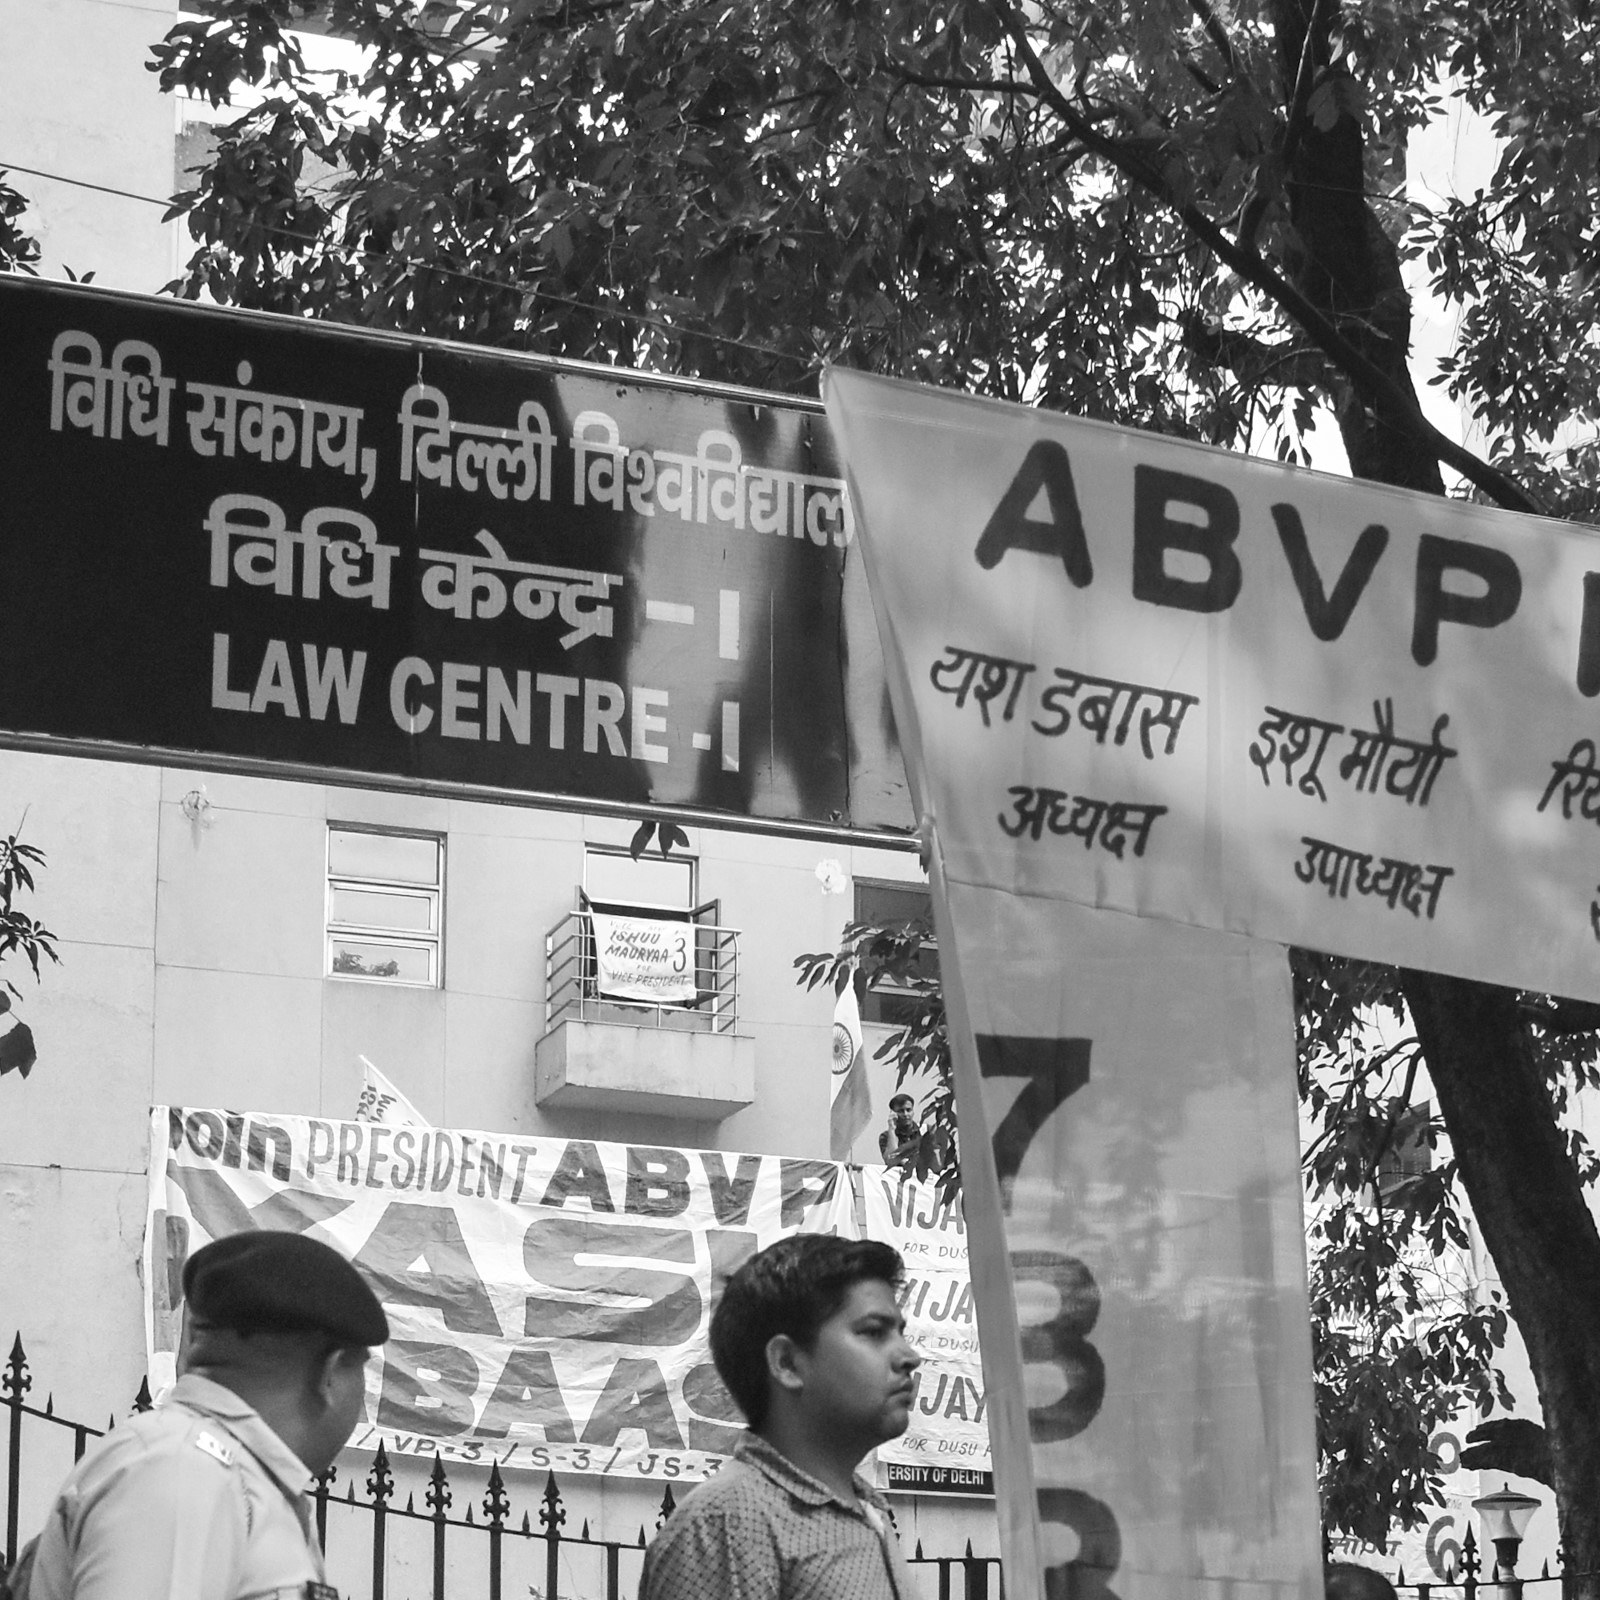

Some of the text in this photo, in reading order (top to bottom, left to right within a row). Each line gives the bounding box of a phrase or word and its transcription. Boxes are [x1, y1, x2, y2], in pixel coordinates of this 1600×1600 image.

[48, 329, 854, 547] विधि संकाय, दिल्ली विश्वविद्याल
[202, 493, 402, 610] विधि
[418, 528, 624, 651] केन्द्र
[973, 438, 1523, 667] ABVP
[209, 633, 368, 726] LAW
[389, 656, 670, 766] CENTRE
[928, 645, 1200, 761] यश डबास
[1247, 703, 1345, 801] इशू
[997, 783, 1169, 861] अध्यक्ष
[1293, 836, 1455, 921] उपाध्यक्ष
[609, 929, 662, 945] ISHUU
[672, 937, 687, 973] 3
[305, 1119, 539, 1206] PRESIDENT
[538, 1139, 848, 1230] ABVP
[902, 1242, 930, 1256] FOR
[530, 1446, 593, 1471] S-3
[901, 1436, 928, 1453] FOR
[937, 1439, 980, 1457] DUSU
[932, 1467, 948, 1484] OF
[950, 1469, 985, 1486] DELHI
